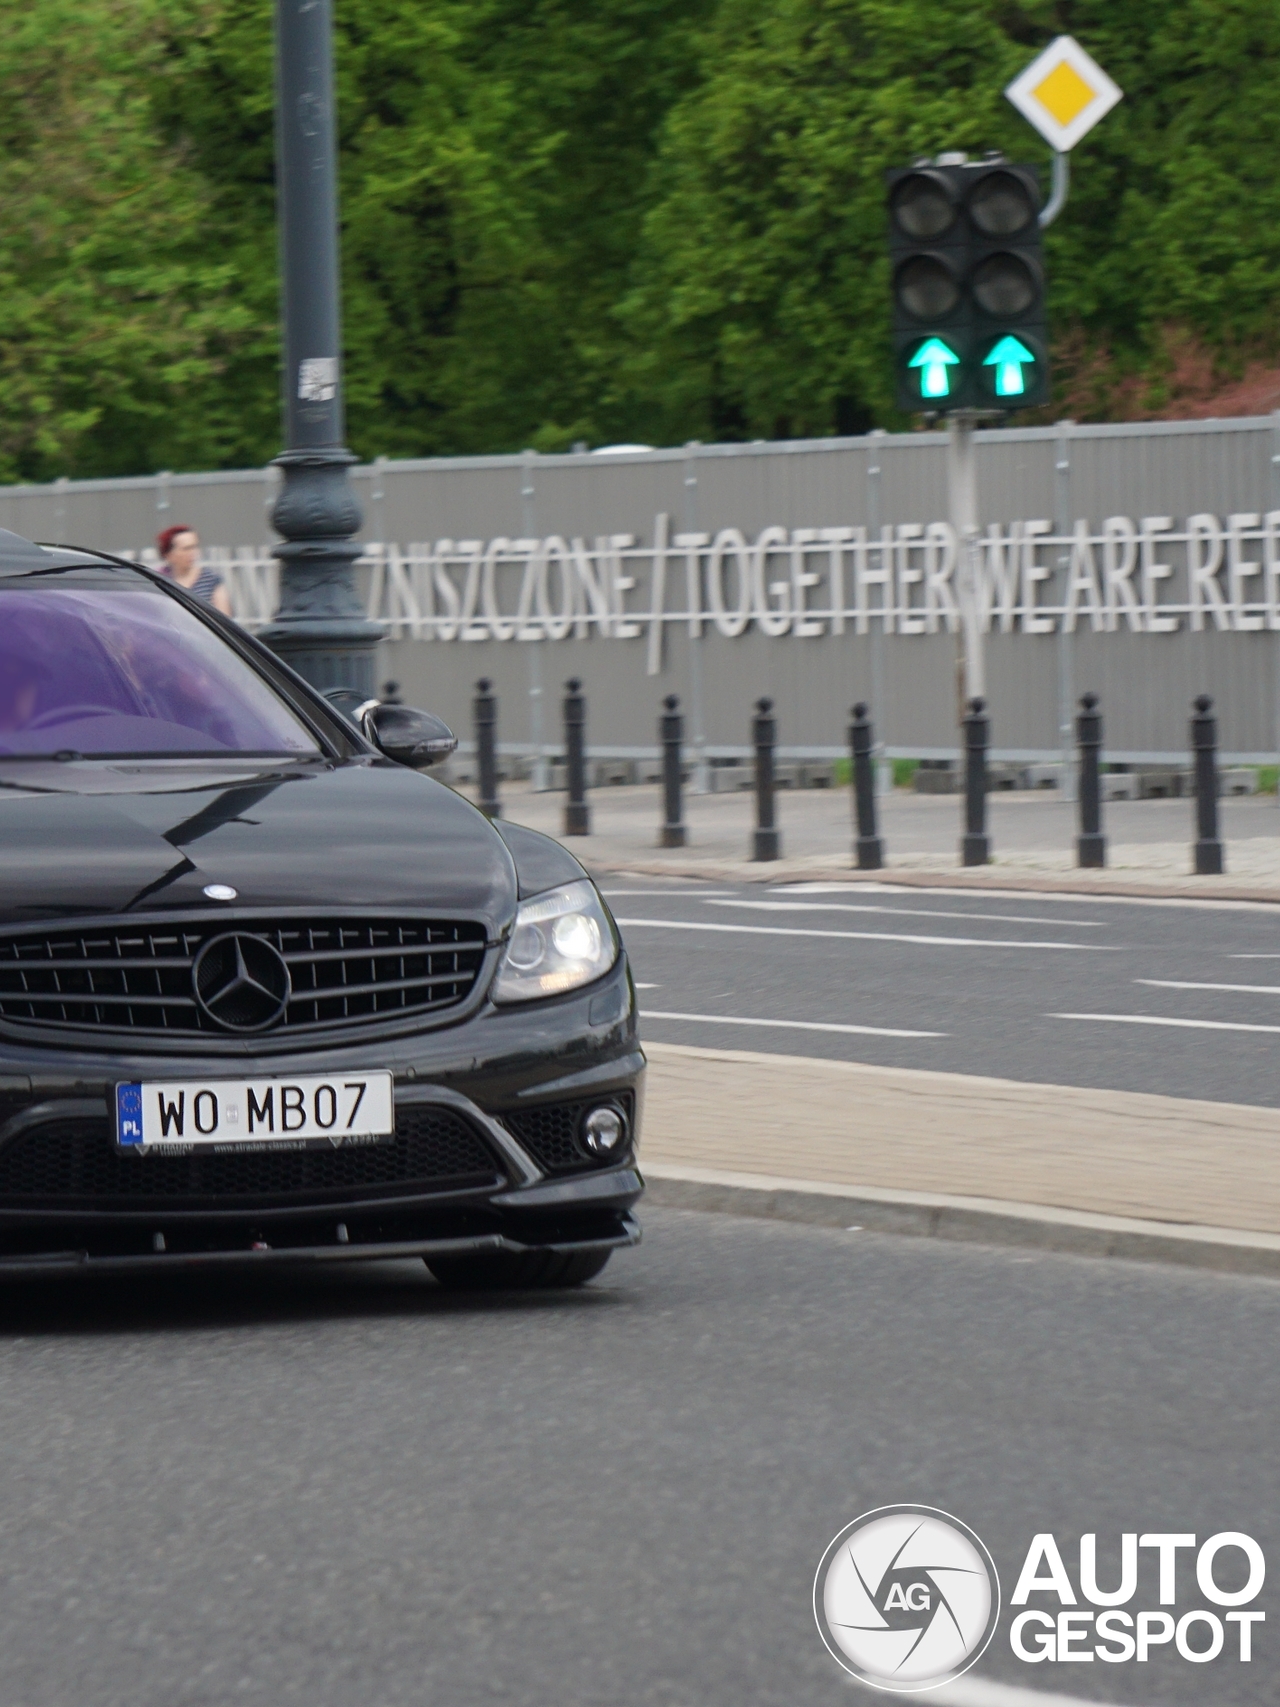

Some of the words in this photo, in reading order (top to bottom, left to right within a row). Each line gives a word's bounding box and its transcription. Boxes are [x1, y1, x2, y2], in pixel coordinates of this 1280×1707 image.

[674, 521, 960, 638] TOGETHER
[970, 519, 1055, 635] WE
[1061, 515, 1179, 633] ARE
[122, 1120, 141, 1136] PL
[157, 1089, 219, 1138] WO
[246, 1082, 368, 1134] MB07
